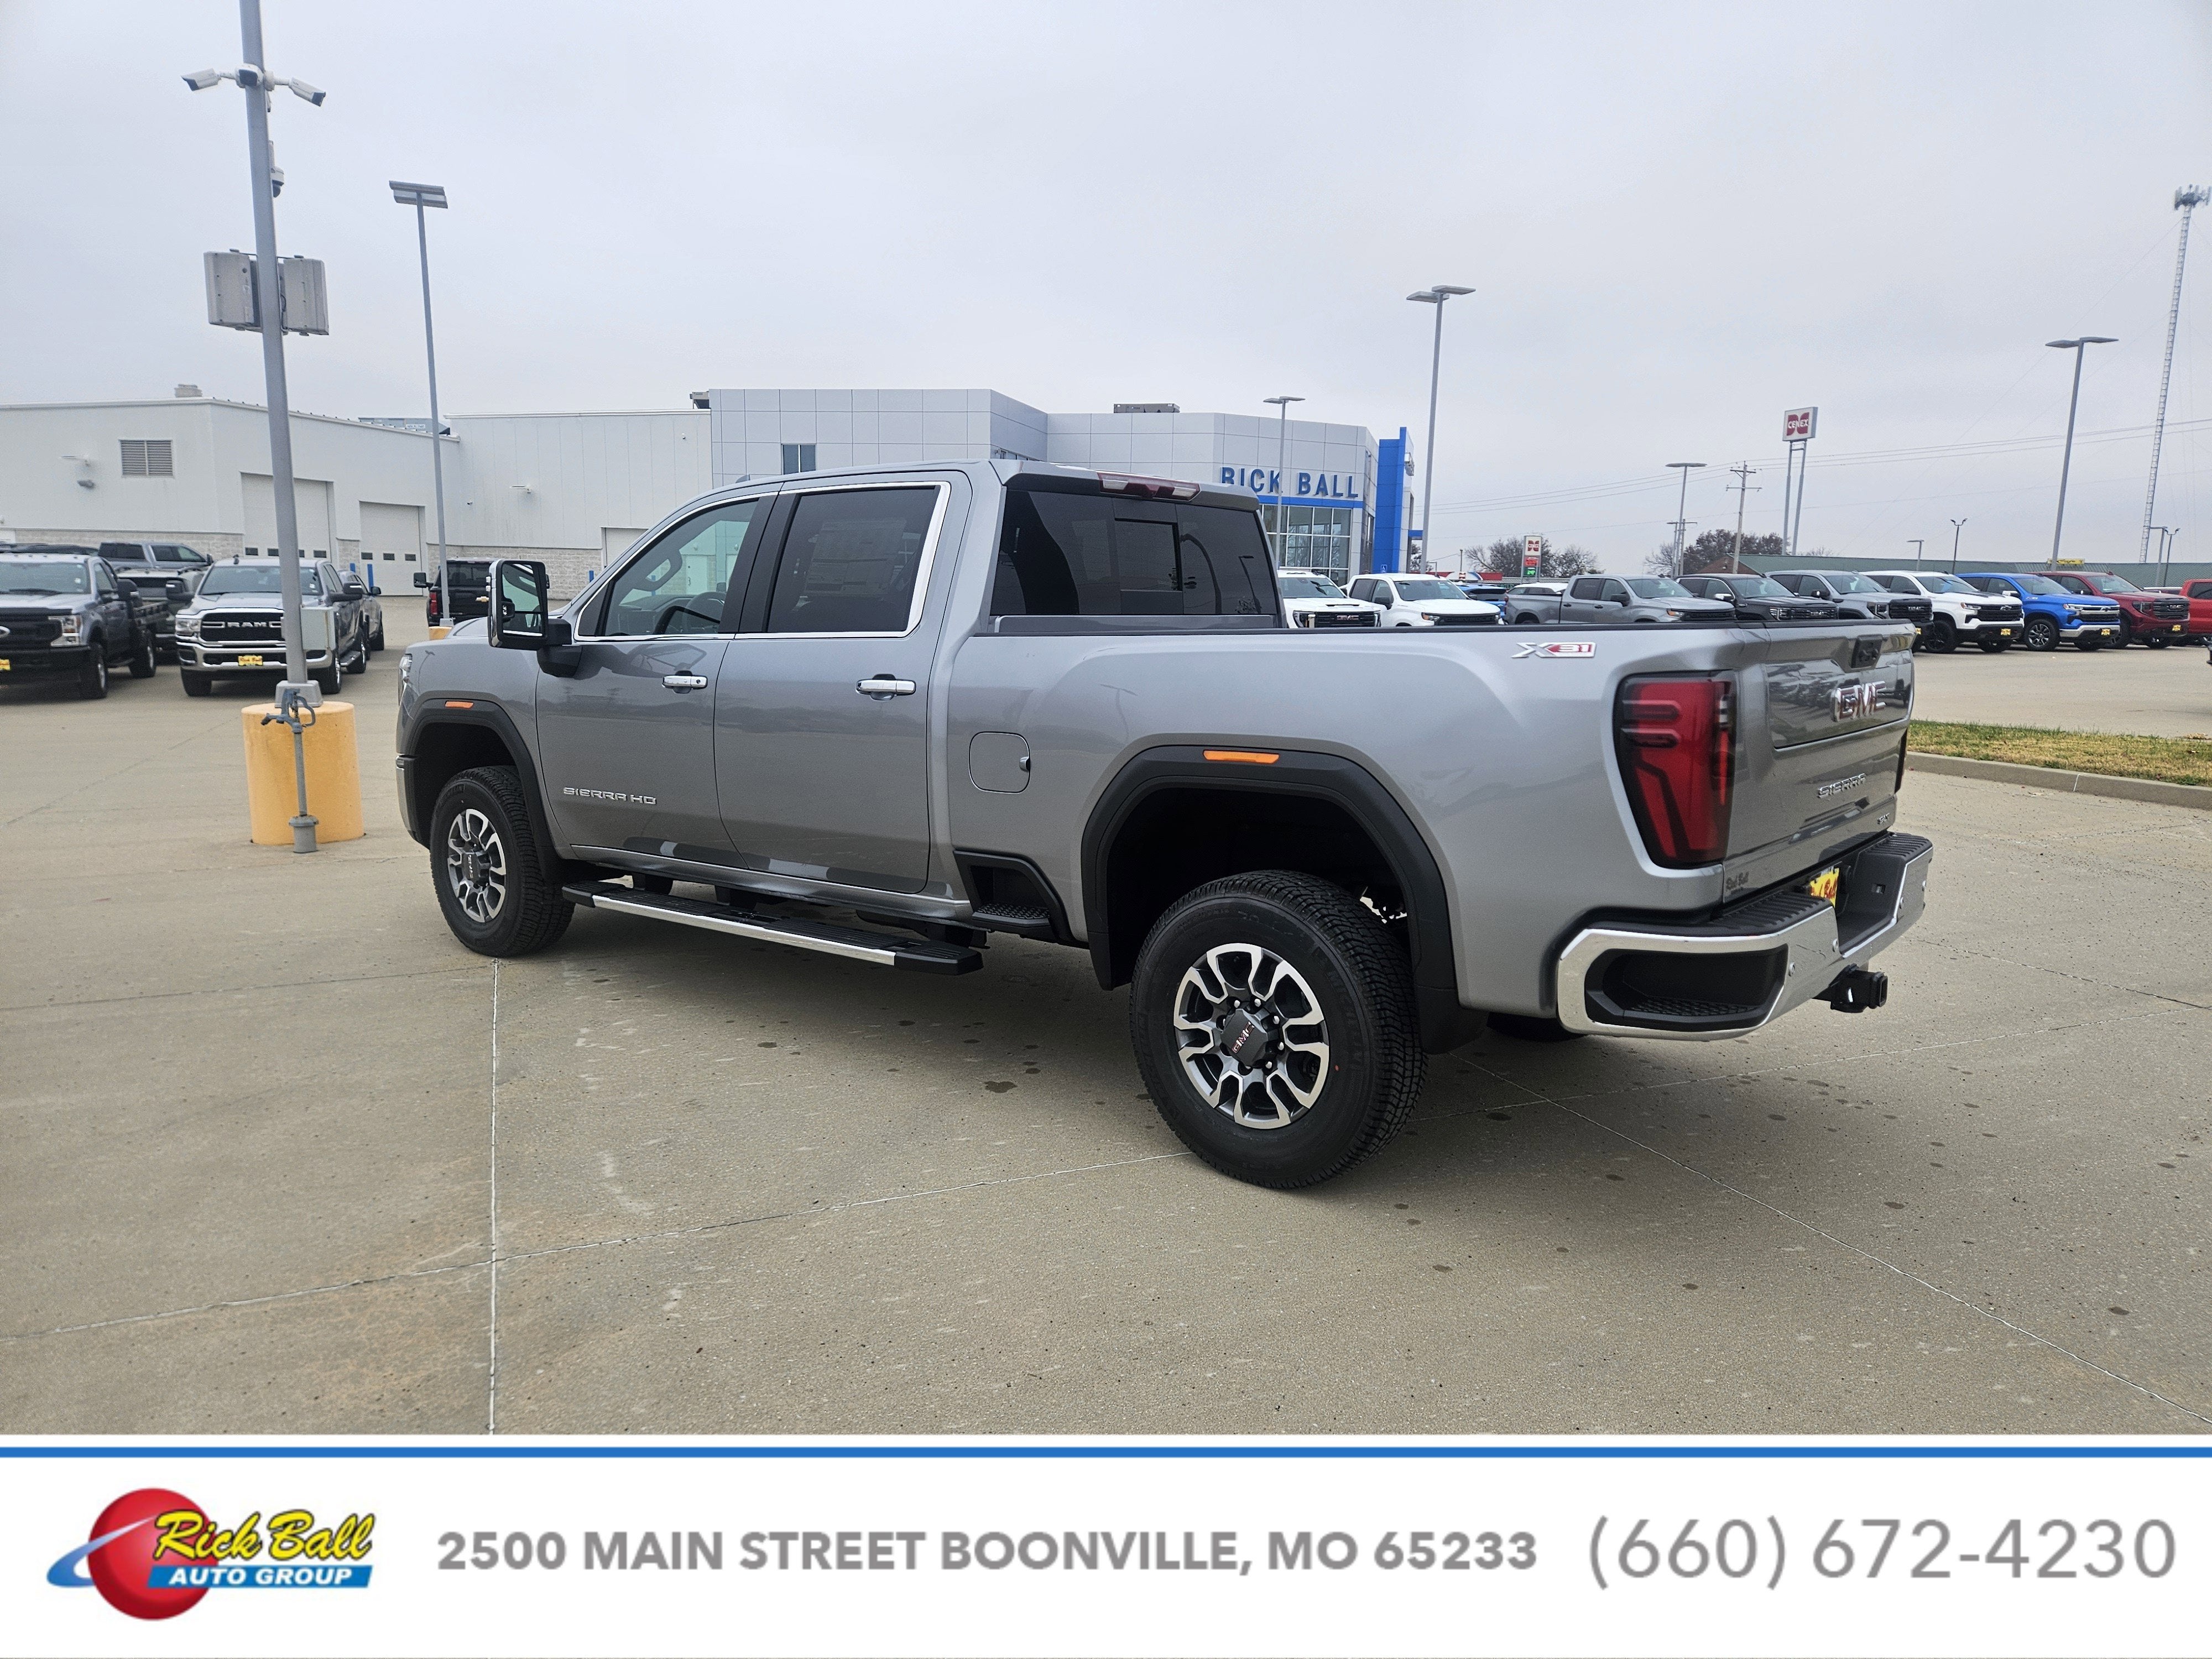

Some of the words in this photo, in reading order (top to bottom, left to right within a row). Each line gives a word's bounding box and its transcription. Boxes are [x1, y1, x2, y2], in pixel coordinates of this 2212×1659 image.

[1788, 419, 1809, 429] CENEX
[1221, 467, 1283, 493] RICK
[1297, 472, 1358, 497] BALL
[1511, 642, 1596, 659] X31
[1834, 680, 1886, 721] GMC
[563, 787, 627, 801] SIERRA
[630, 794, 656, 805] HD
[1817, 773, 1867, 799] SIERRA
[1232, 1021, 1255, 1053] GMC
